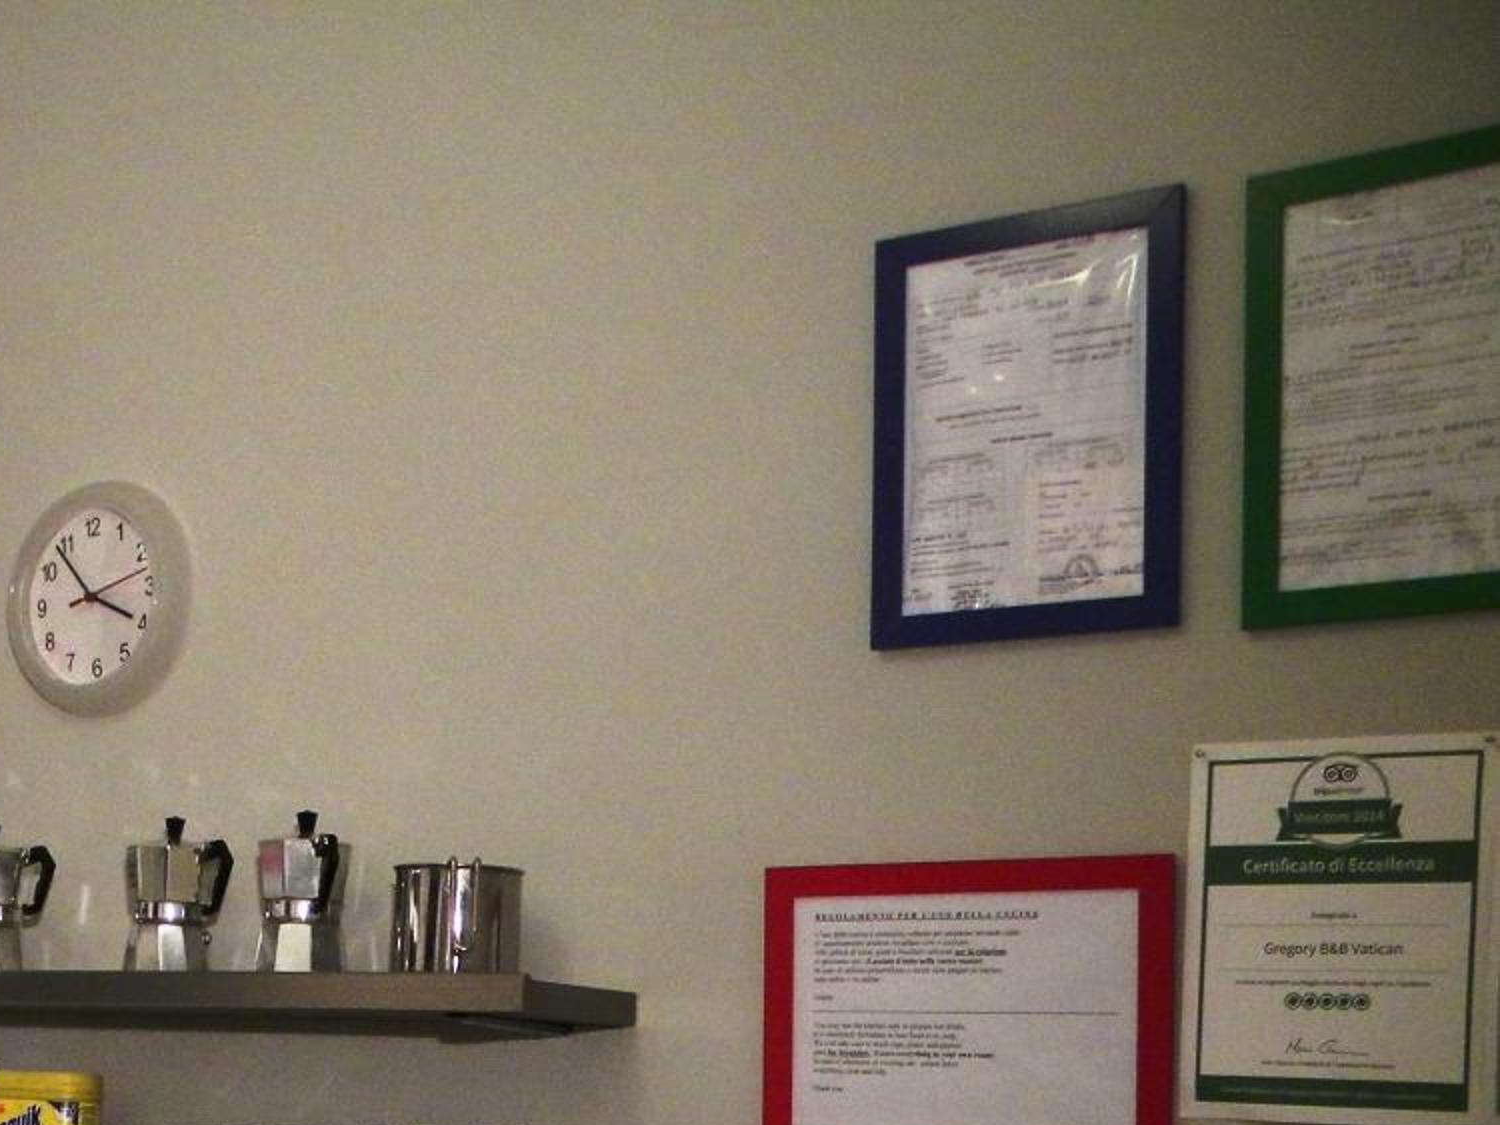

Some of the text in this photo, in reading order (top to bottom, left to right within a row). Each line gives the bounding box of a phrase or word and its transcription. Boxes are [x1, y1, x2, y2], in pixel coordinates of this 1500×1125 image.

[85, 517, 101, 537] 12
[116, 522, 124, 541] 1
[60, 535, 74, 553] 11
[136, 542, 147, 562] 2
[42, 562, 57, 582] 10
[144, 575, 153, 597] 3
[37, 599, 47, 618] 9
[137, 613, 147, 629] 4
[45, 632, 55, 651] 8
[119, 642, 131, 662] 5
[66, 653, 75, 672] 7
[92, 658, 103, 678] 6
[1243, 855, 1435, 875] Certificato di Eccellenza
[1264, 942, 1405, 958] Gregory B&B Vatican
